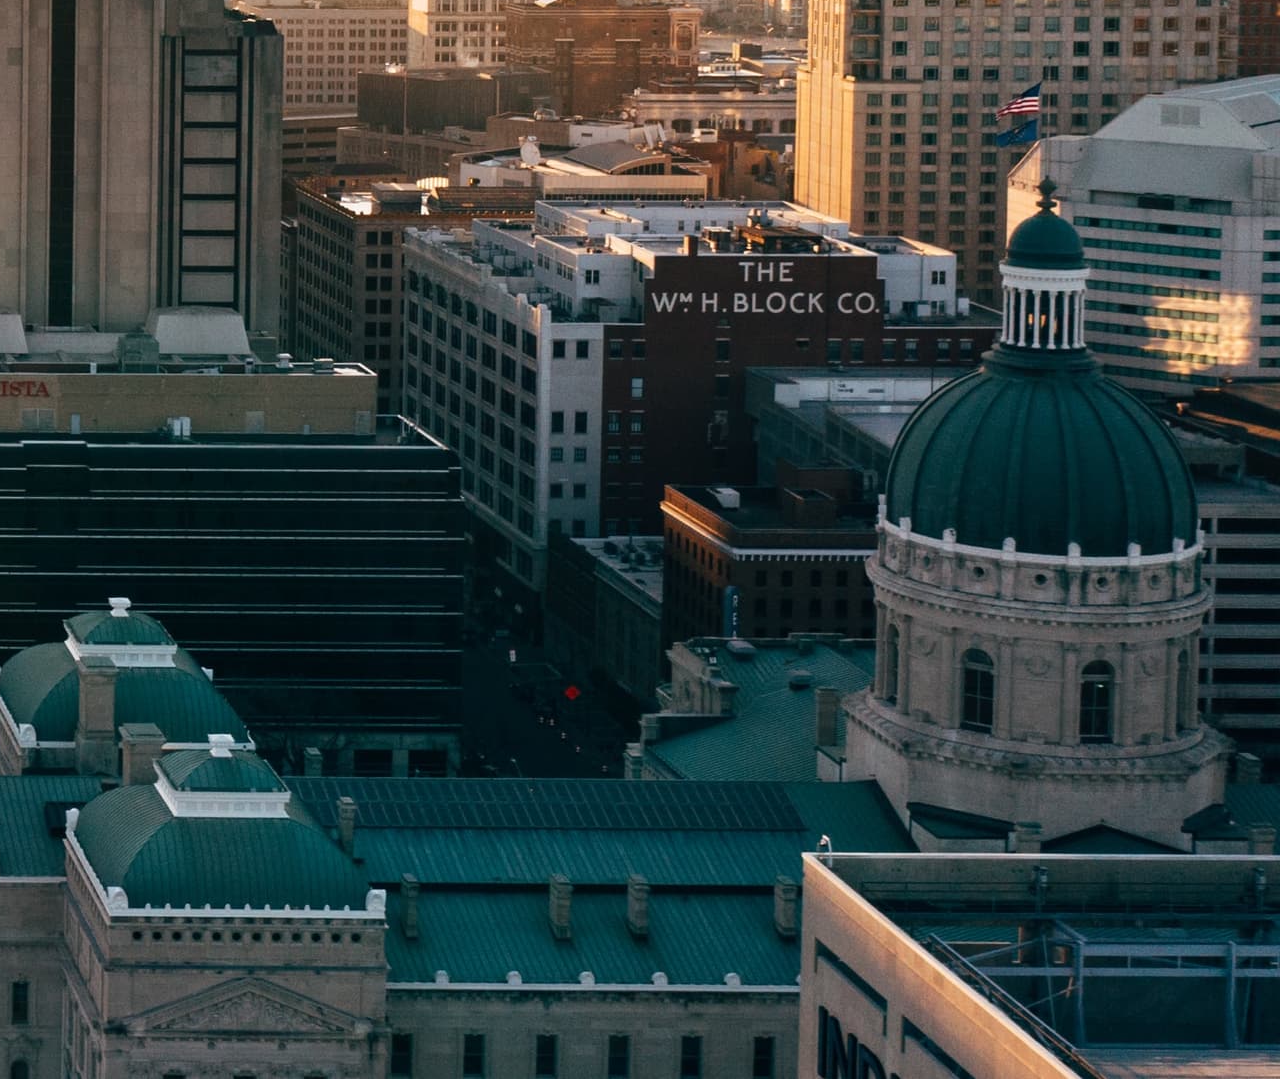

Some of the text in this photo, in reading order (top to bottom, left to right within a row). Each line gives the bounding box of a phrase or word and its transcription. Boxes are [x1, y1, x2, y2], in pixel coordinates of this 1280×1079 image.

[739, 262, 794, 282] THE
[702, 292, 727, 313] H.
[734, 292, 824, 313] BLOCK
[838, 292, 880, 313] CO.
[0, 381, 50, 397] ISTA
